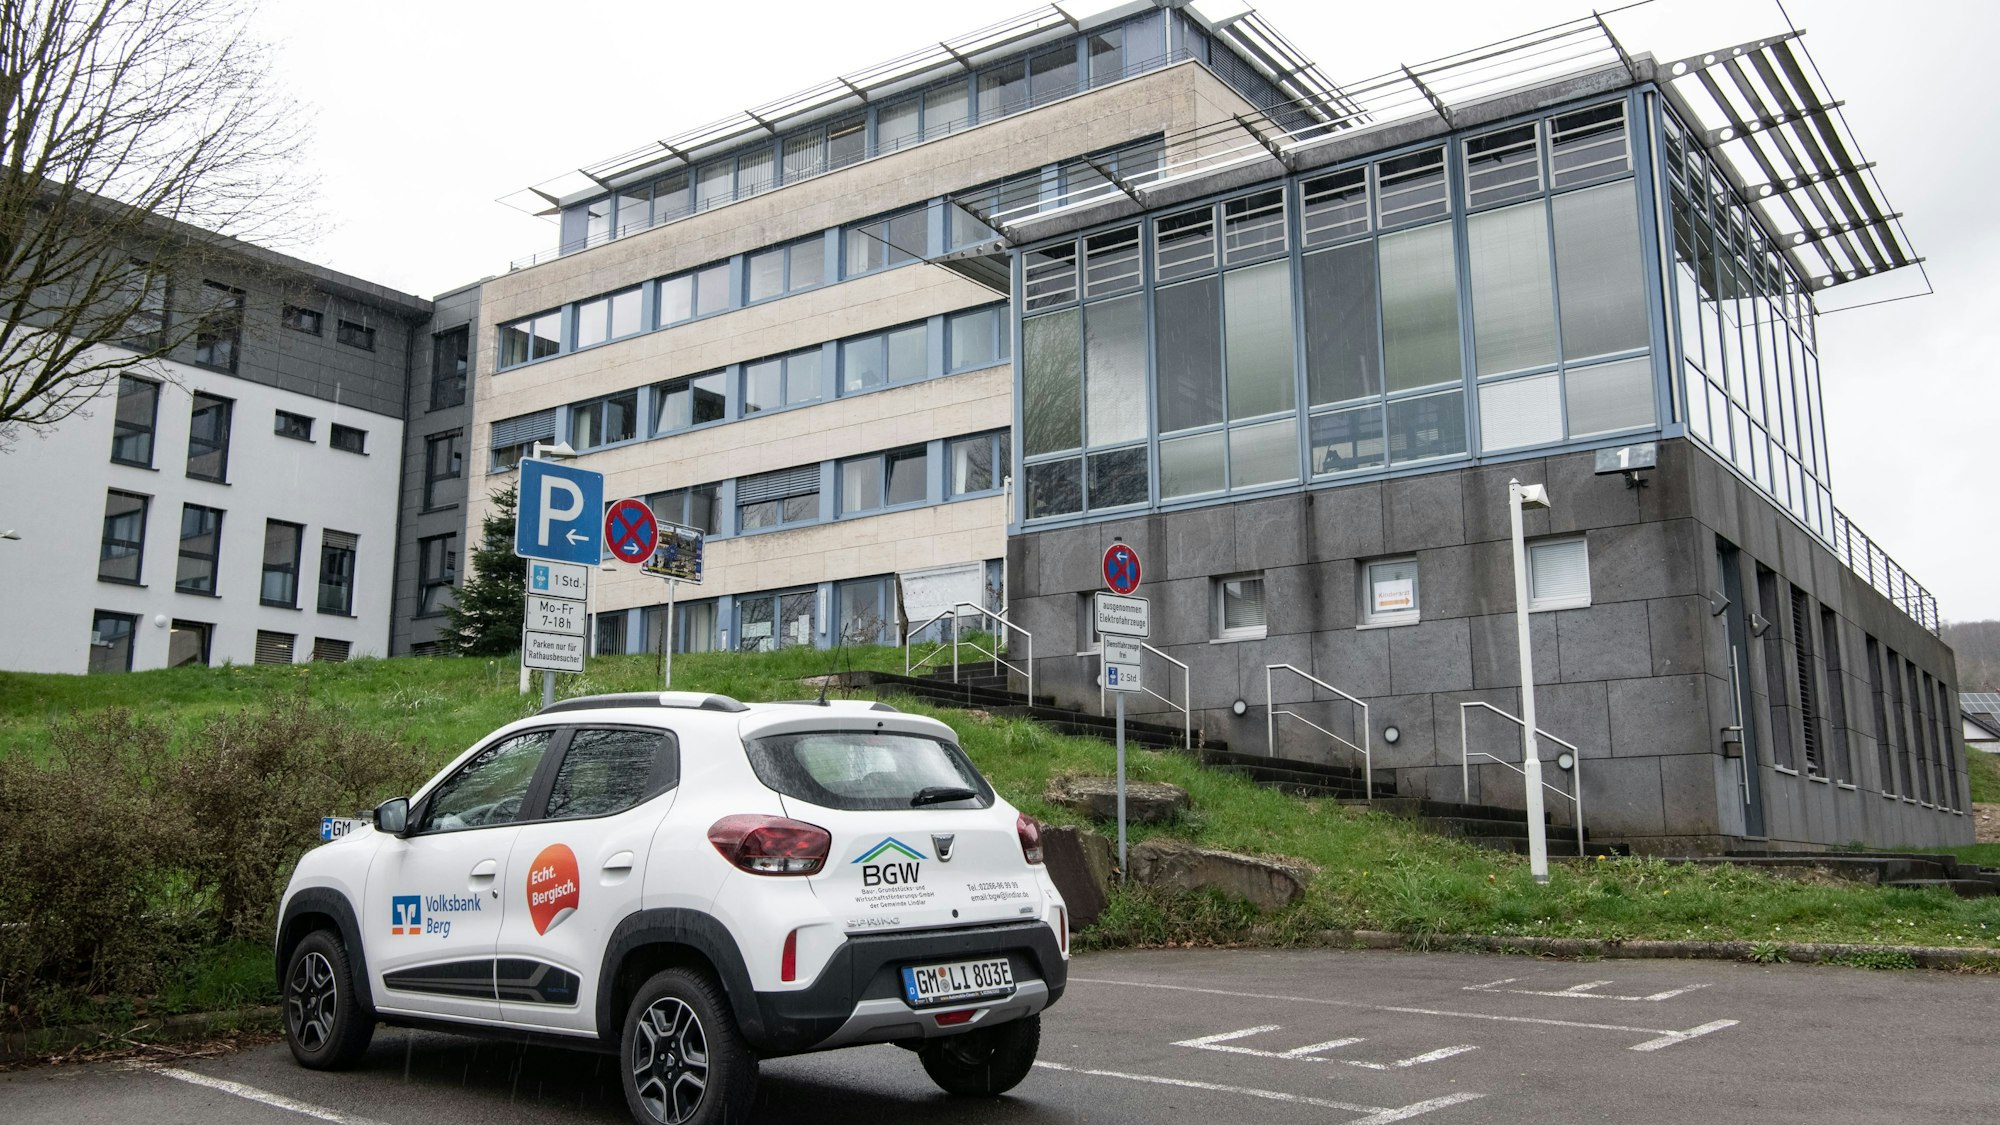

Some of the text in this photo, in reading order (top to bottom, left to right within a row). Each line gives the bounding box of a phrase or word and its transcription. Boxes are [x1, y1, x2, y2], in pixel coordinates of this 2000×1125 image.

[1616, 447, 1630, 468] 1
[538, 474, 584, 547] P
[554, 574, 582, 588] 1 Std.
[1378, 590, 1410, 599] Kinderarzt
[539, 600, 574, 615] Mo-Fr
[1103, 602, 1142, 614] ausgenommen
[1099, 612, 1146, 629] Elektrofahrzeuge
[533, 639, 577, 652] Parken nur für
[1106, 639, 1140, 652] Dienstfahrzeuge
[528, 650, 580, 663] Rathausbesucher
[1119, 650, 1127, 659] frei
[1120, 672, 1125, 682] 2
[531, 865, 557, 886] Echt.
[862, 861, 920, 887] BGW
[532, 879, 577, 907] Bergisch.
[425, 893, 482, 912] Volksbank
[426, 917, 451, 939] Berg
[847, 916, 901, 928] SPRING
[916, 962, 1013, 994] GM LI 803E
